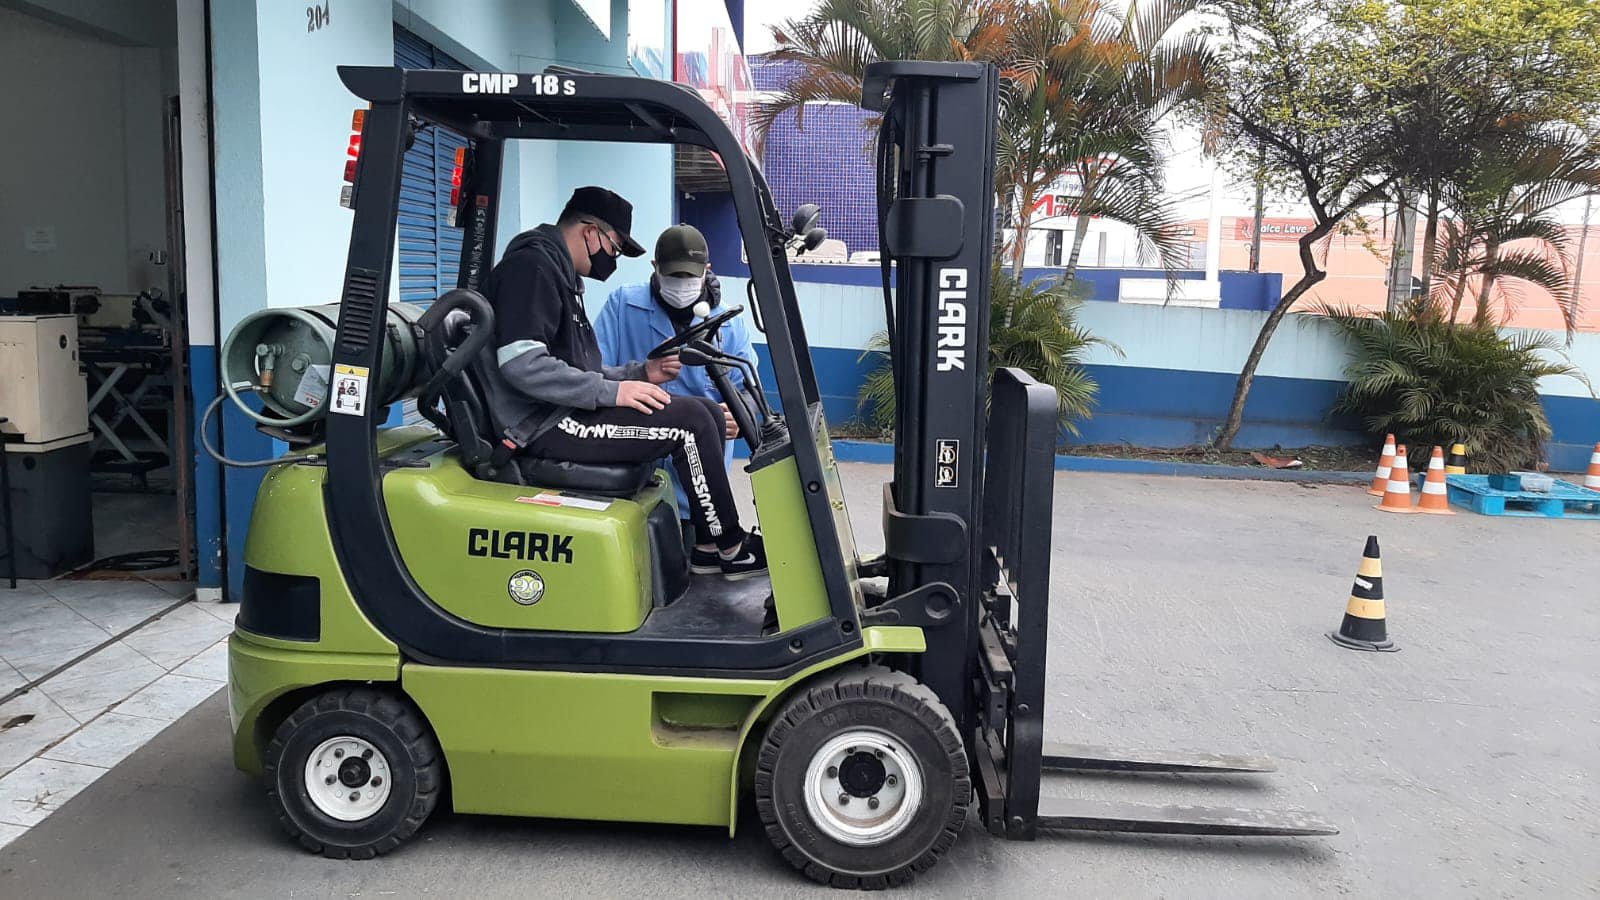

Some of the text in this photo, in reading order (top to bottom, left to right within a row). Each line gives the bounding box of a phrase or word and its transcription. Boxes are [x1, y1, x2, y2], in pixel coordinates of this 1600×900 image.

[462, 73, 519, 94] CMP
[937, 268, 968, 371] CLARK
[468, 528, 574, 564] CLARK
